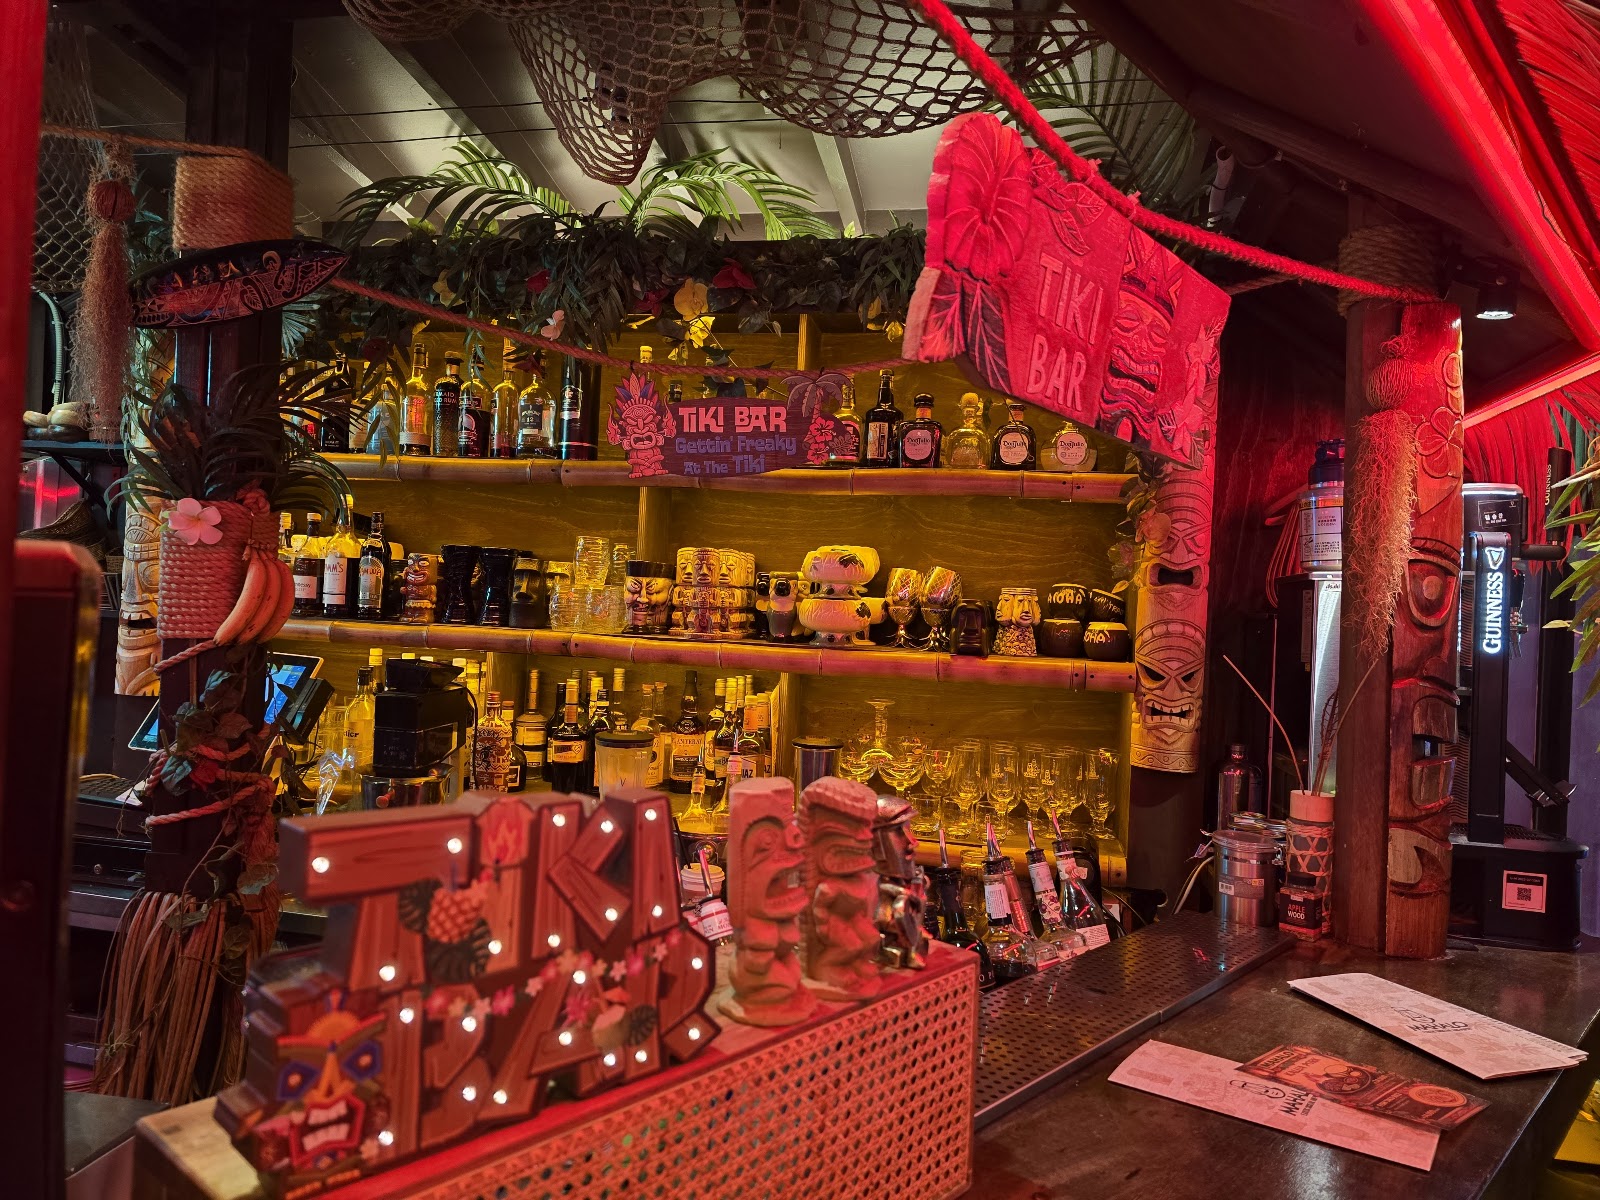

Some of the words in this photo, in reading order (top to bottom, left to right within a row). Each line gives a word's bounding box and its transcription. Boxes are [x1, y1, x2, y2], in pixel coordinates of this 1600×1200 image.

[1038, 252, 1104, 346] TIKI
[1026, 333, 1088, 412] BAR
[678, 406, 724, 433] TIKI
[734, 406, 787, 433] BAR
[675, 436, 733, 454] Gettin'
[737, 435, 797, 456] Freaky
[684, 462, 700, 475] At
[703, 461, 728, 474] The
[733, 454, 765, 474] Tiki
[1544, 463, 1553, 506] GUINNESS
[1482, 571, 1503, 654] GUINNESS
[305, 798, 680, 992] TIKI
[1287, 903, 1306, 914] APPLE
[1287, 910, 1306, 920] WOOD
[1406, 1020, 1469, 1032] MAHALO
[1259, 1050, 1295, 1068] MAHALO
[1278, 1089, 1306, 1117] MAHAL
